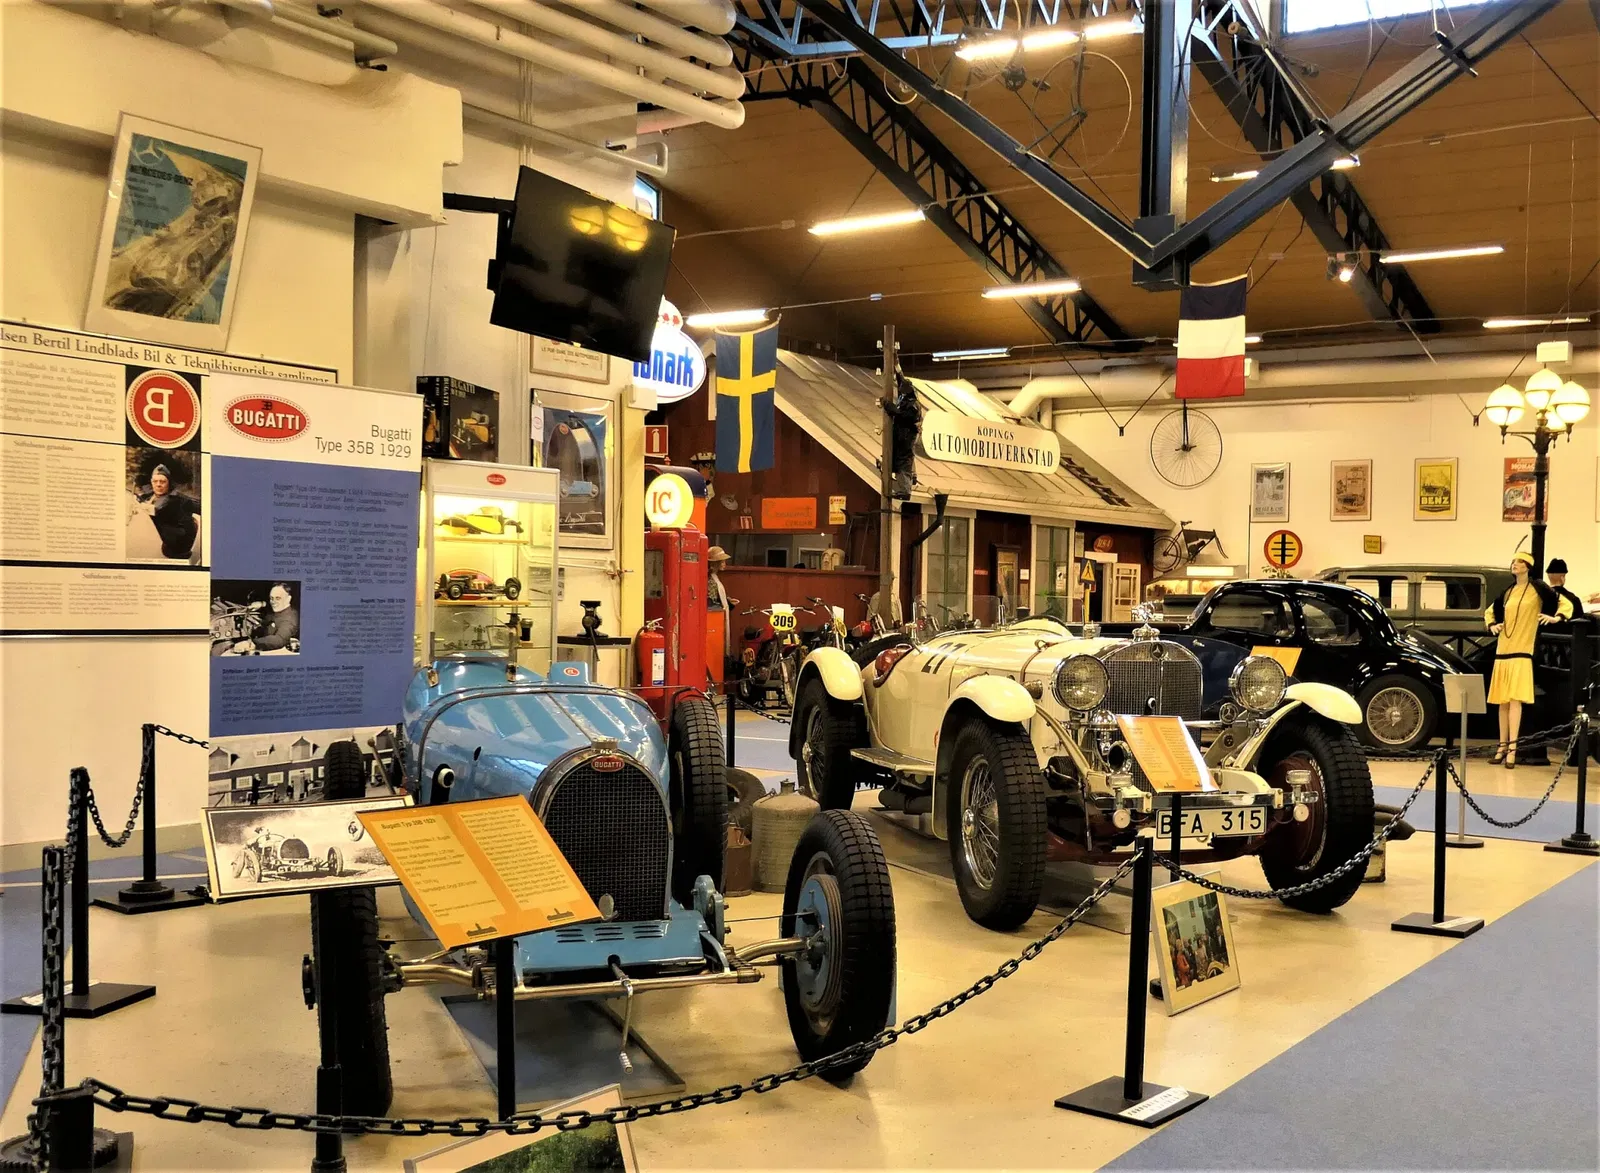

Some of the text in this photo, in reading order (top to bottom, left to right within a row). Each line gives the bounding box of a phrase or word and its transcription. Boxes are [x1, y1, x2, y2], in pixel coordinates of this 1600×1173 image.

[33, 332, 70, 350] Bertil
[76, 339, 139, 359] Lindblads
[143, 349, 160, 363] Bil
[165, 353, 176, 365] &
[233, 408, 300, 431] BUGATTI
[371, 424, 412, 442] Bugatti
[314, 437, 412, 459] Type 35B 1929
[930, 432, 1054, 468] AUTOMOBILVERKSTAD
[652, 491, 672, 514] IC
[1421, 496, 1450, 505] BENZ
[773, 614, 794, 629] 309
[594, 761, 622, 769] BUGATTI
[1221, 809, 1262, 831] 315
